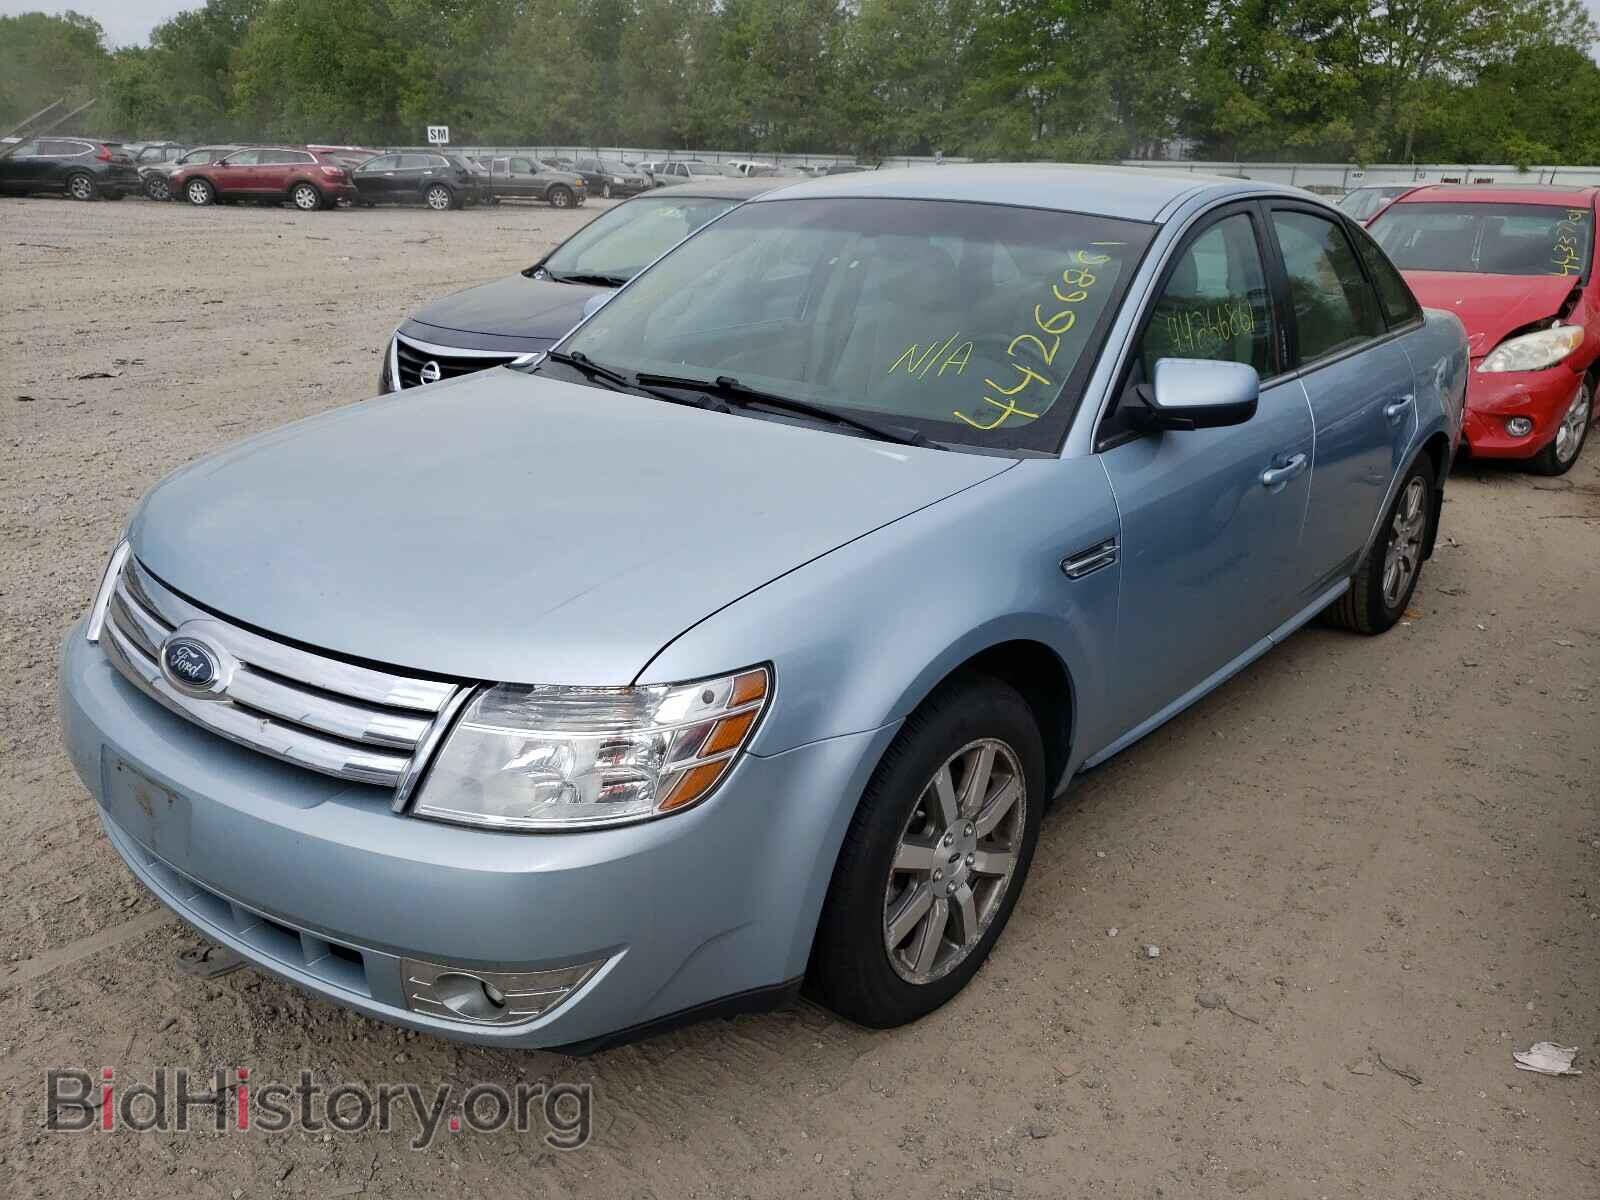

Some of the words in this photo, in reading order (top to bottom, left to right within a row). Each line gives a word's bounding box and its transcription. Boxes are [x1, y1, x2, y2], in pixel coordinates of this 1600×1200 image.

[430, 129, 447, 140] SM
[887, 330, 976, 380] N/A
[953, 240, 1127, 429] 44266861
[171, 646, 205, 678] Ford
